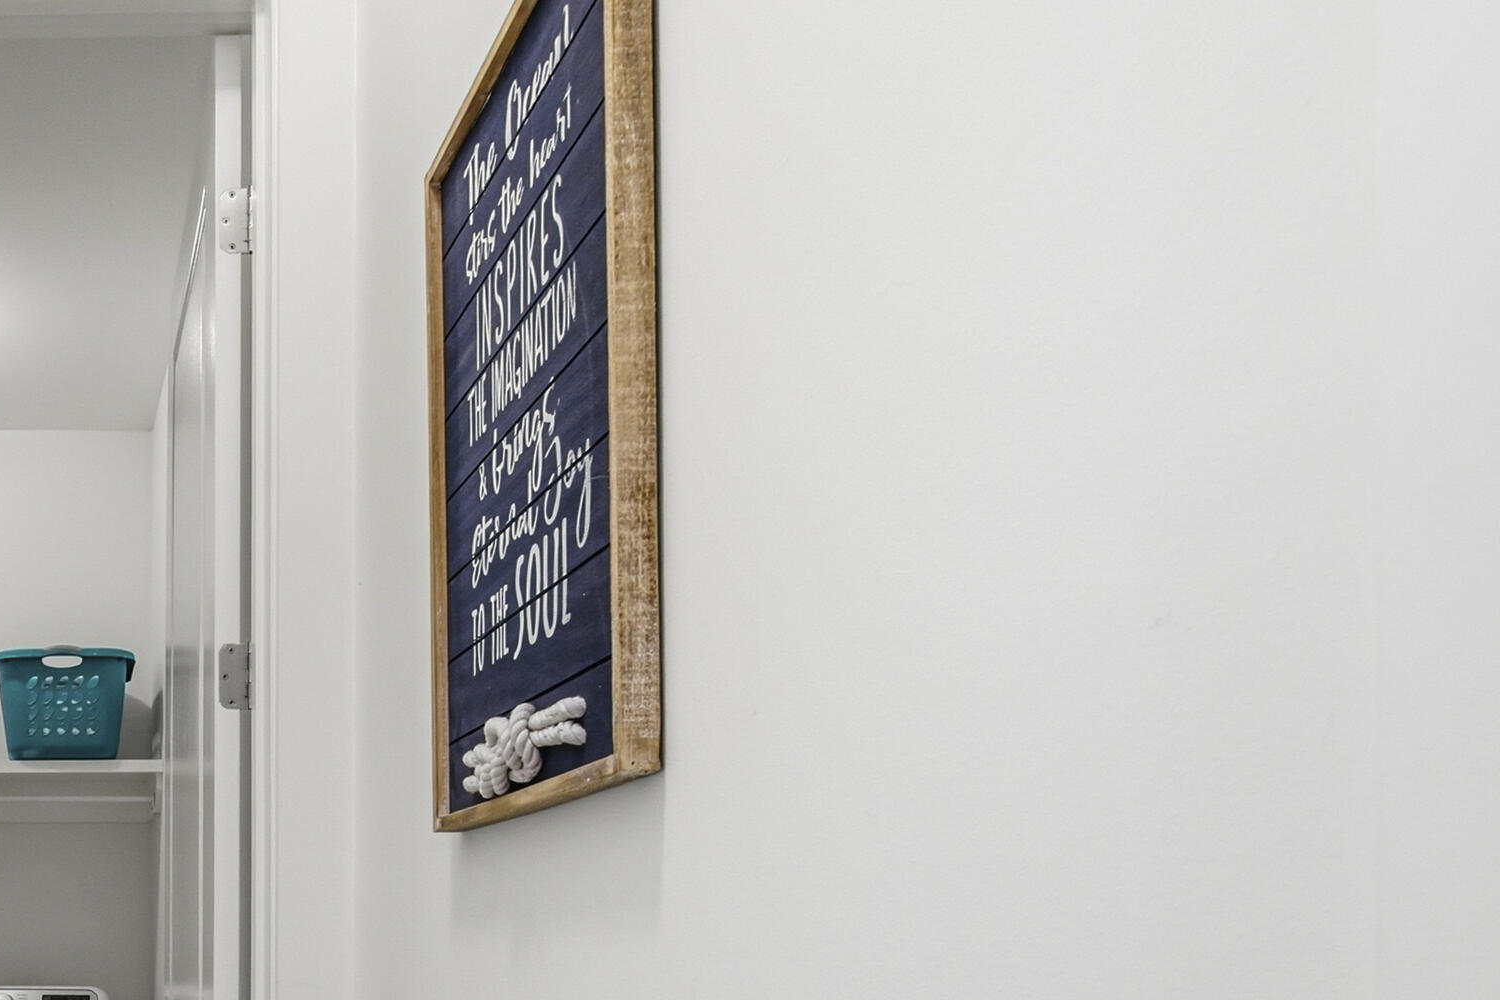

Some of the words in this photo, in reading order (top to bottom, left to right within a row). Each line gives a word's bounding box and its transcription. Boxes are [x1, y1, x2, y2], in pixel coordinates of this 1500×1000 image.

[463, 142, 498, 226] The
[505, 4, 574, 161] Ocean
[465, 209, 497, 286] stirs
[497, 176, 524, 234] the
[529, 82, 572, 188] heart
[467, 371, 488, 448] THE
[491, 261, 577, 423] IMAGINATION
[476, 173, 564, 371] INSPIRES
[478, 462, 488, 501] &
[492, 376, 557, 495] brings
[544, 435, 594, 549] Joy
[471, 603, 485, 676] TO
[490, 584, 509, 664] THE
[513, 516, 572, 660] SOUL
